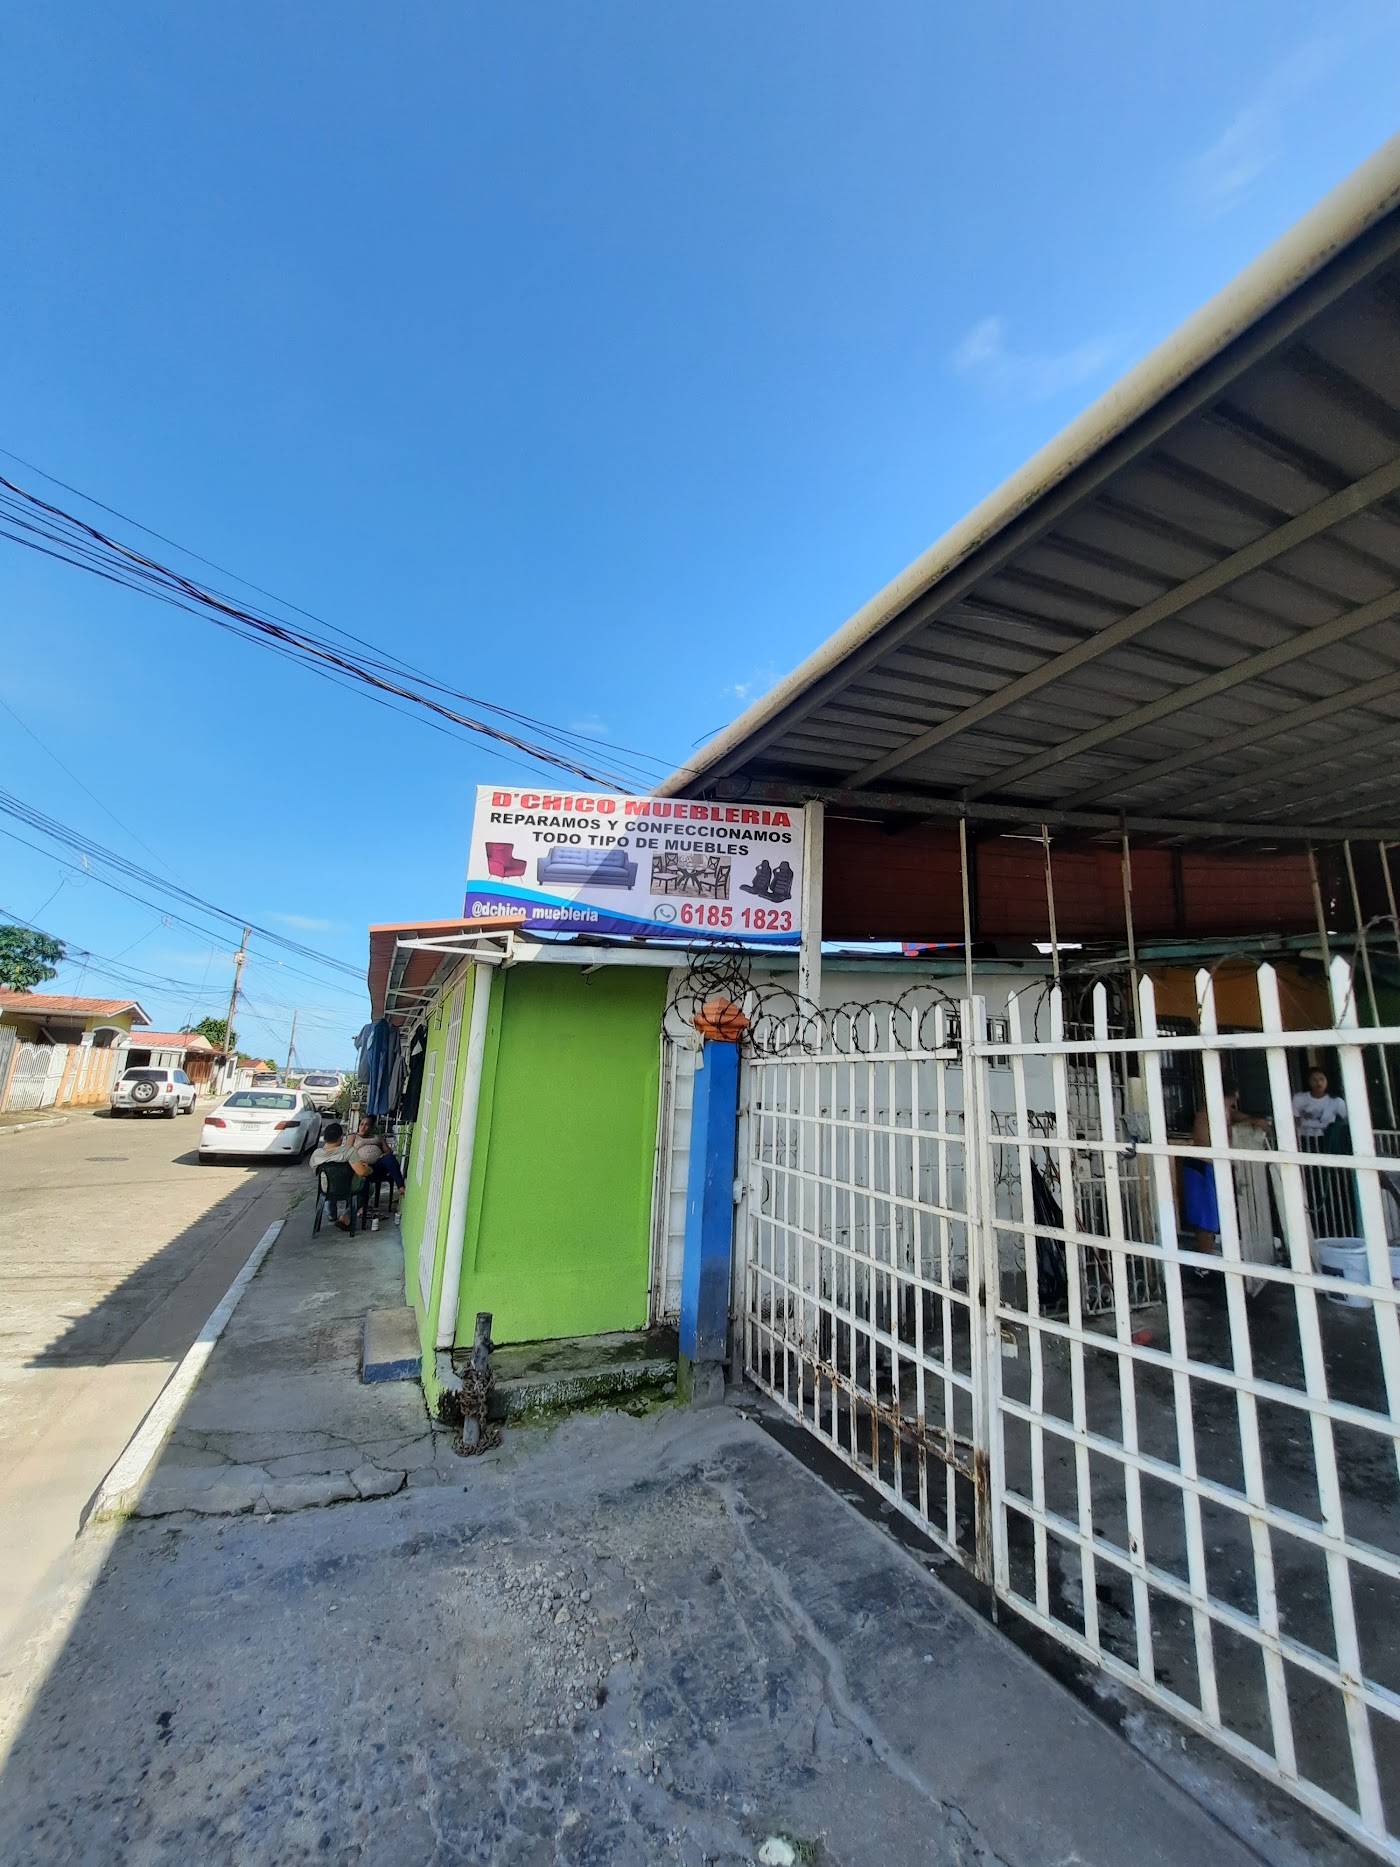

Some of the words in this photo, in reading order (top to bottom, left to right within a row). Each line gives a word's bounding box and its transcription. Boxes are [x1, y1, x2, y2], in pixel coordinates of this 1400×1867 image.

[492, 791, 616, 815] D'CHICO
[624, 800, 791, 828] MUEBLERIA
[490, 812, 601, 830] REPARAMOS
[607, 820, 619, 831] Y
[625, 821, 792, 844] CONFECCIONAMOS
[532, 831, 582, 845] TODO
[587, 834, 630, 847] TIPO
[635, 837, 659, 849] DE
[664, 839, 749, 856] MUEBLES
[681, 903, 733, 928] 6185
[741, 907, 792, 932] 1823
